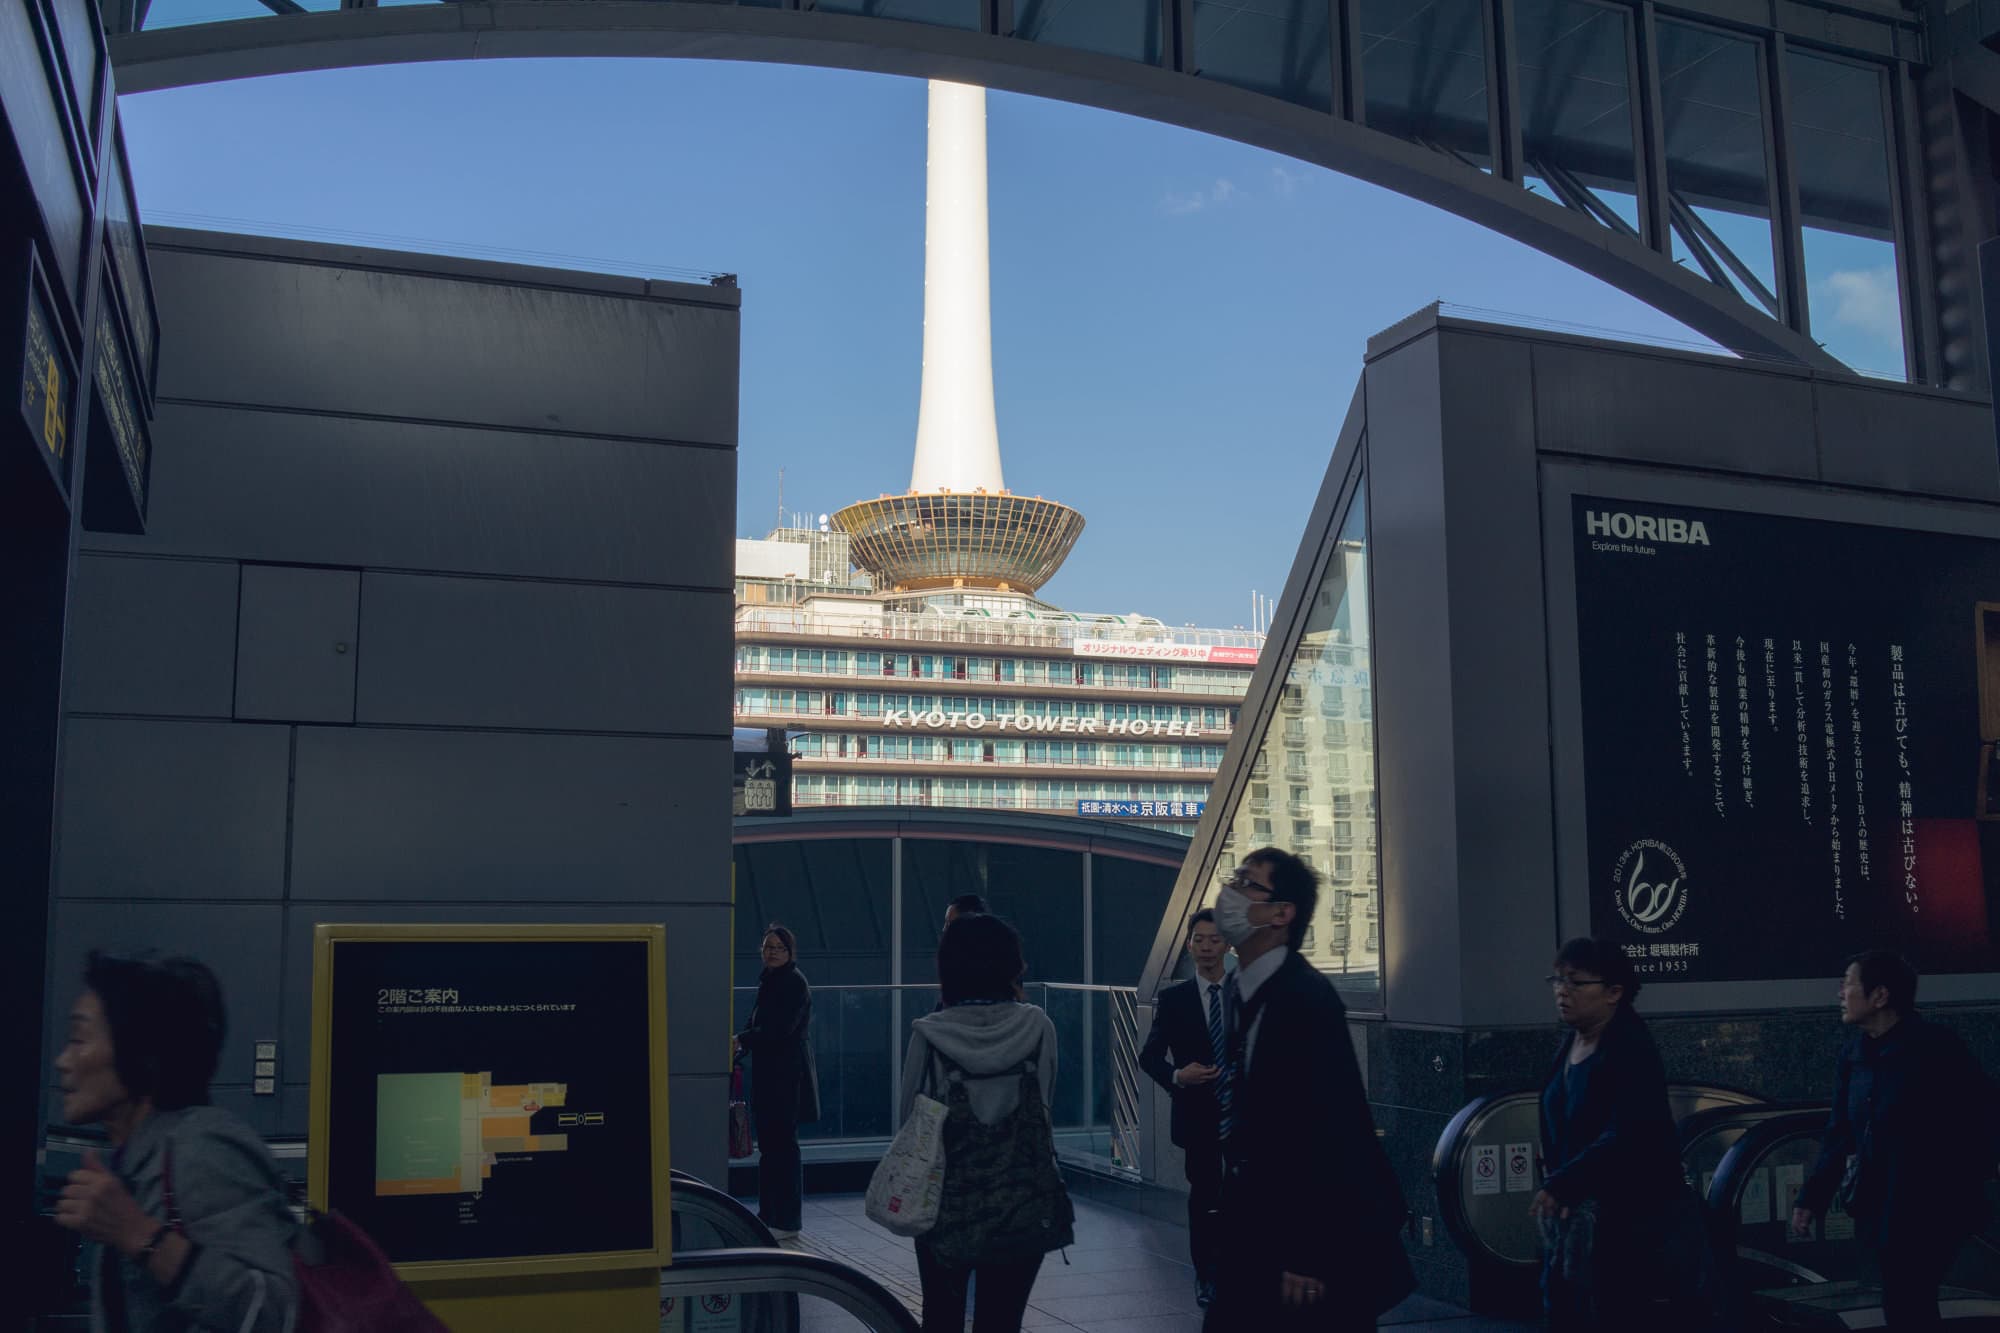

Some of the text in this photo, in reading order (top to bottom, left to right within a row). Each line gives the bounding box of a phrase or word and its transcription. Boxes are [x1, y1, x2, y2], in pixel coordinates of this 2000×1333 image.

[1585, 510, 1711, 546] HORIBA
[1592, 541, 1656, 555] Explore the future
[883, 708, 1201, 738] KYOTO TOWER HOTEL
[1890, 643, 1920, 913] 製品は古びても、精神は古びない。
[1650, 944, 1699, 957] 堀場製作所
[1658, 961, 1688, 973] 1953
[377, 988, 459, 1004] 2階ご案内
